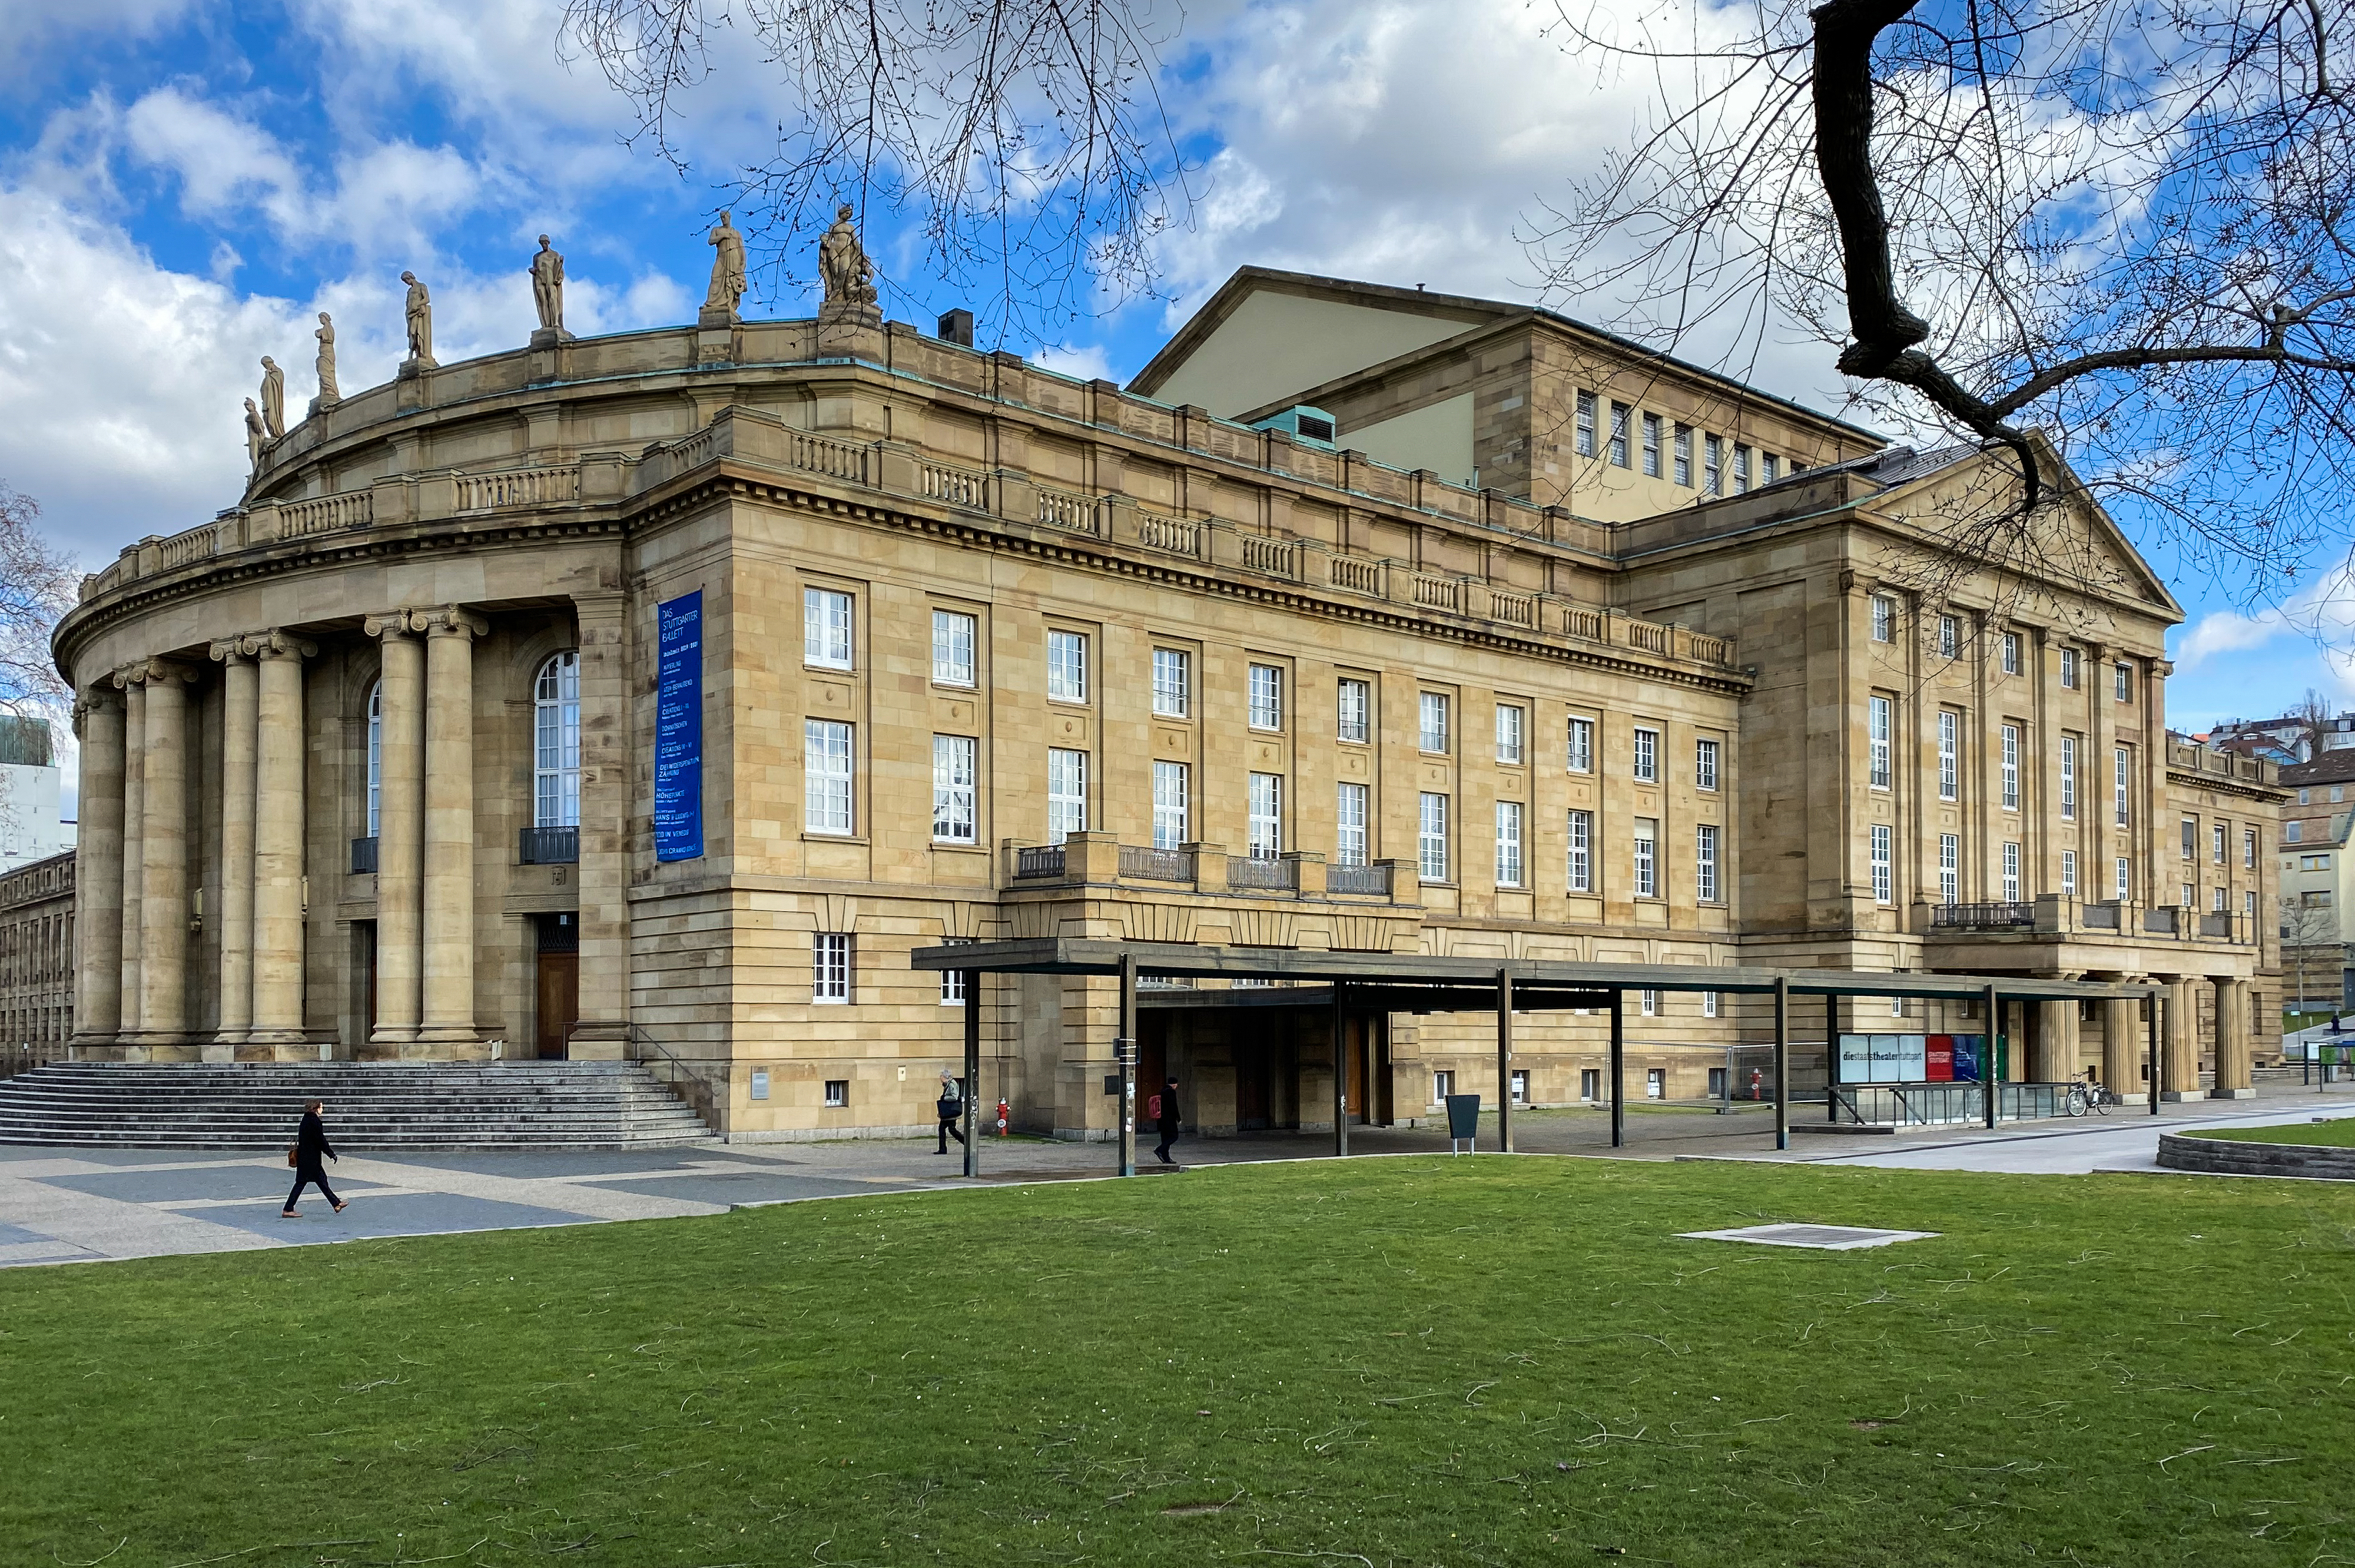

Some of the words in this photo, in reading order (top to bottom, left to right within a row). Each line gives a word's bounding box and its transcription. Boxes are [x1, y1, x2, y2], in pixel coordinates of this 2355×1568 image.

[662, 608, 672, 619] DAS
[663, 609, 698, 631] STUTTGARTER
[662, 626, 684, 642] BALLETT
[1843, 1051, 1922, 1063] diestaatstheatertuttgart
